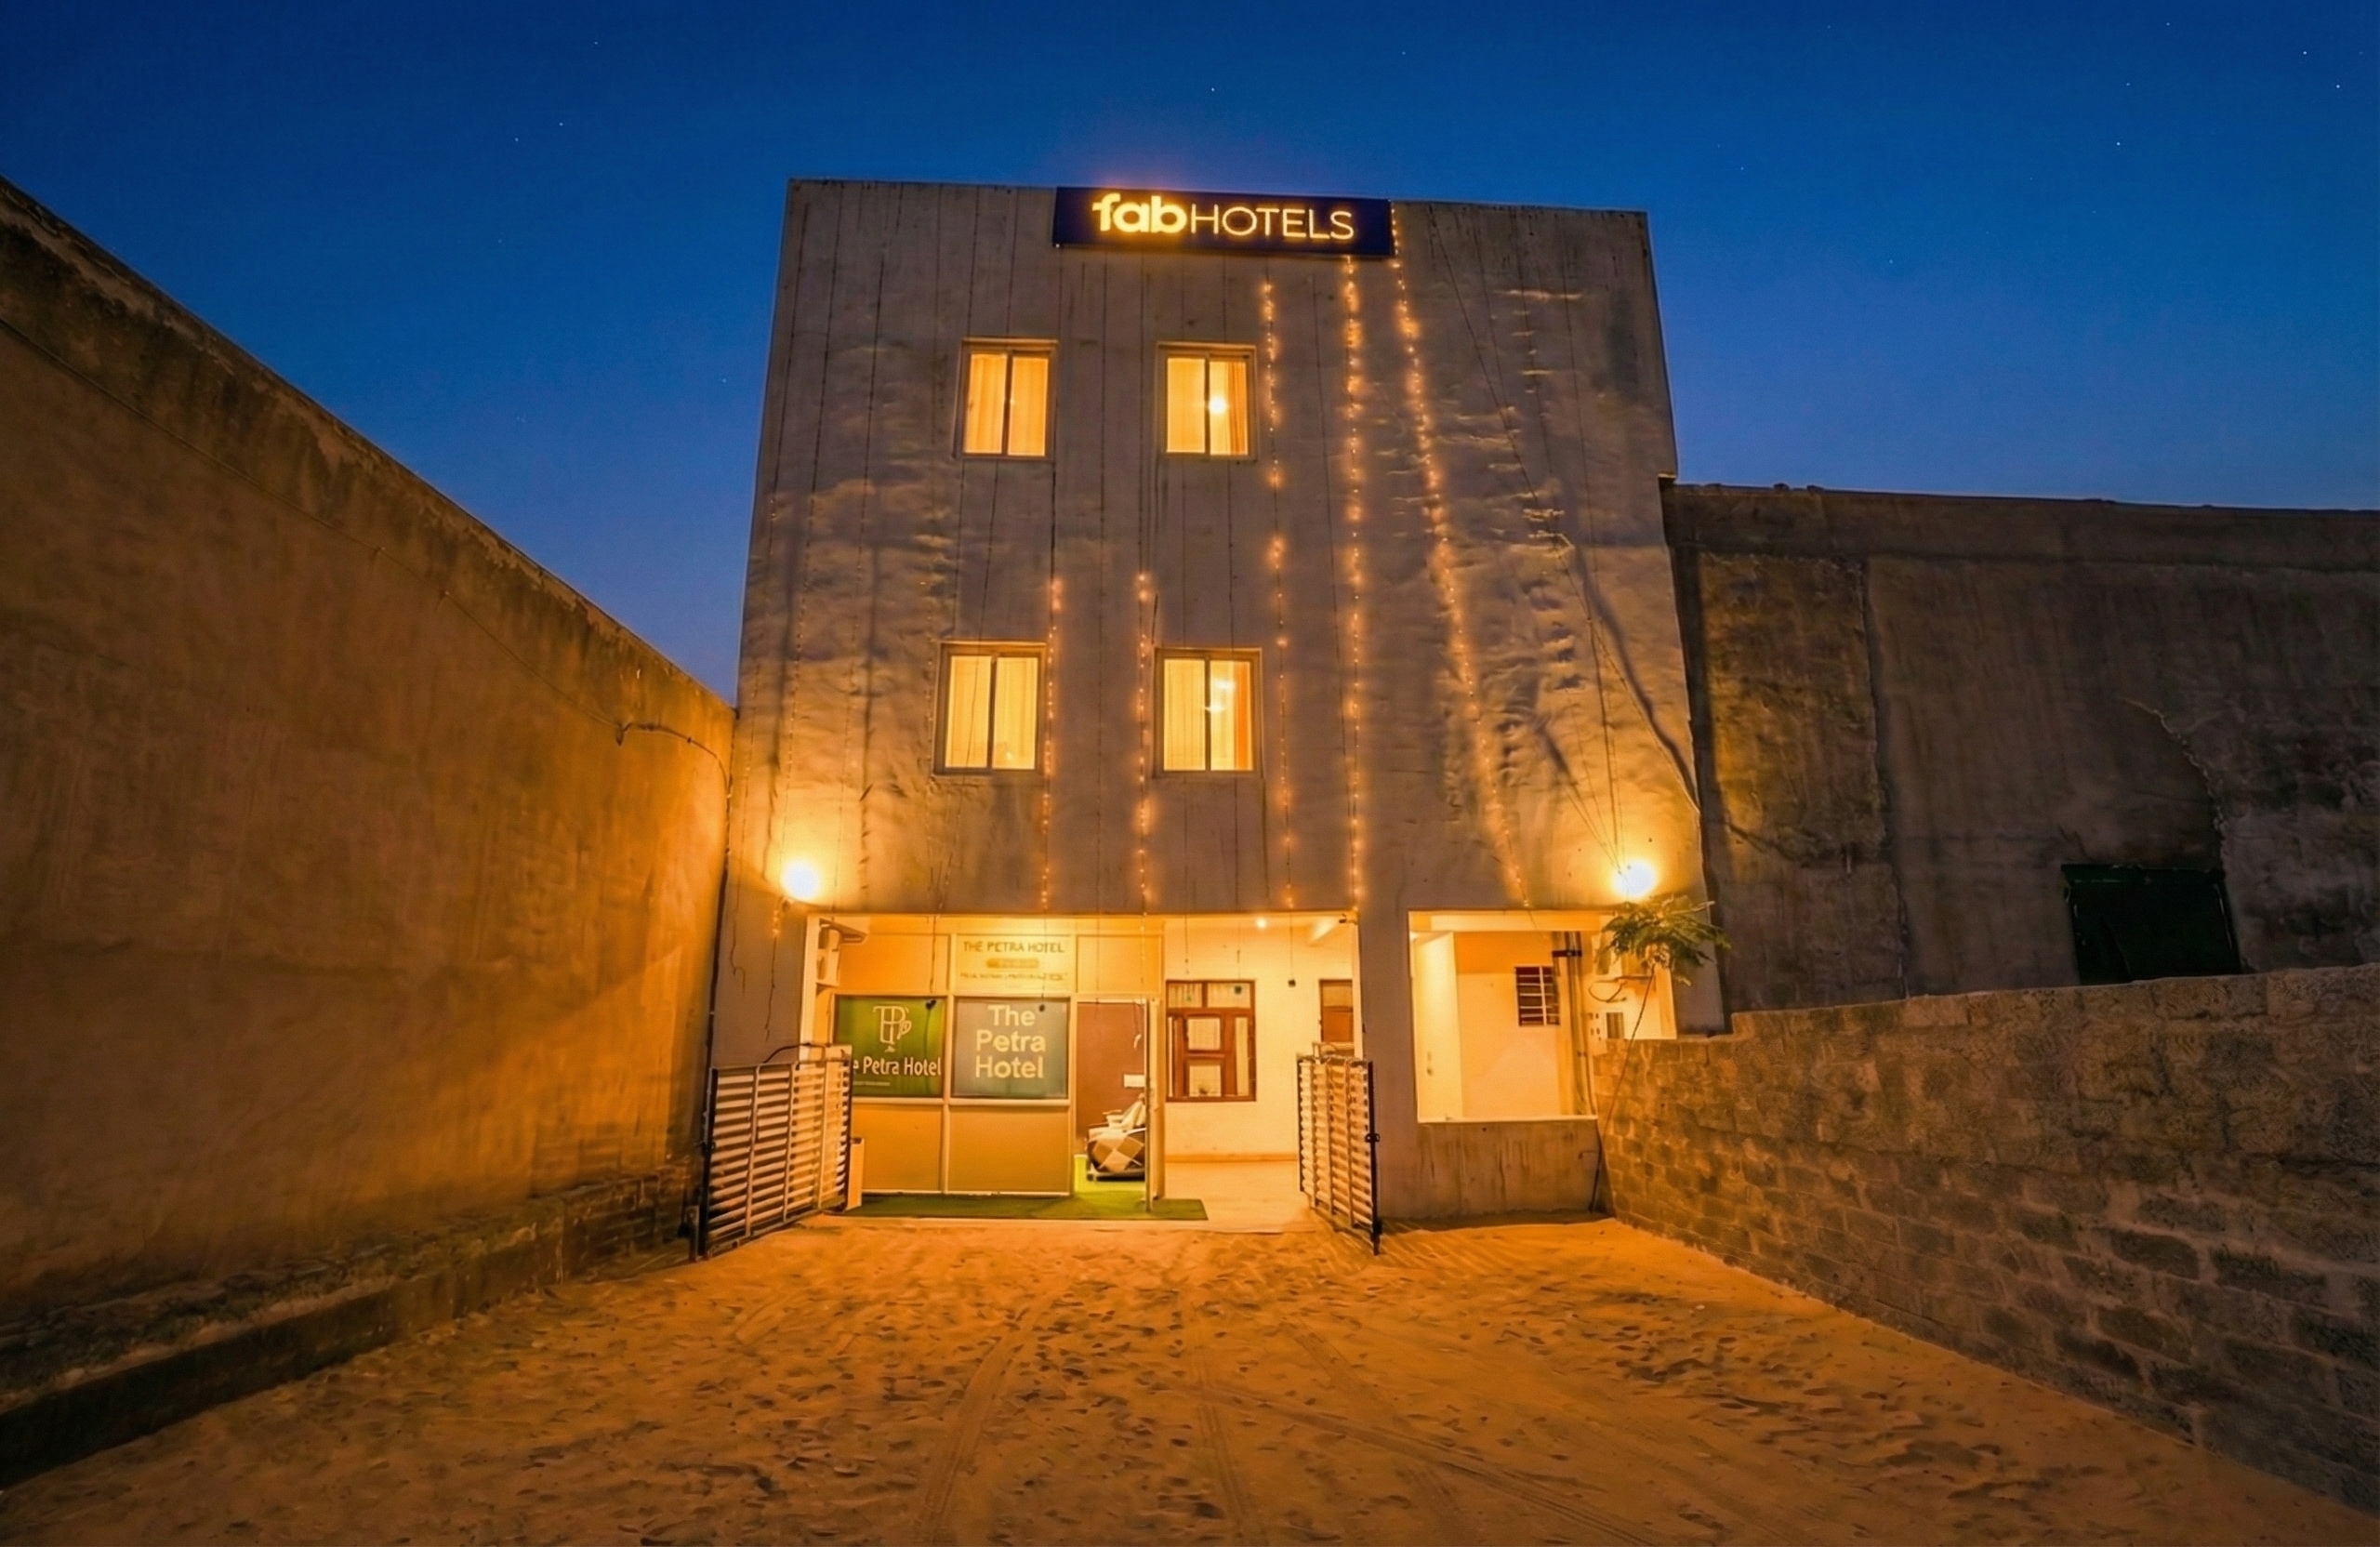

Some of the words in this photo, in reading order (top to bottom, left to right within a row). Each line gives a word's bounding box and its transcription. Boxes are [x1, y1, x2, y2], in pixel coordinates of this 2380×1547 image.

[963, 941, 984, 953] THE
[986, 941, 1025, 953] PETRA
[1027, 942, 1065, 954] HOTEL
[987, 1004, 1036, 1026] The
[976, 1029, 1046, 1052] Petra
[863, 1055, 900, 1075] Petra
[904, 1056, 942, 1077] Hotel
[975, 1055, 1044, 1078] Hotel
